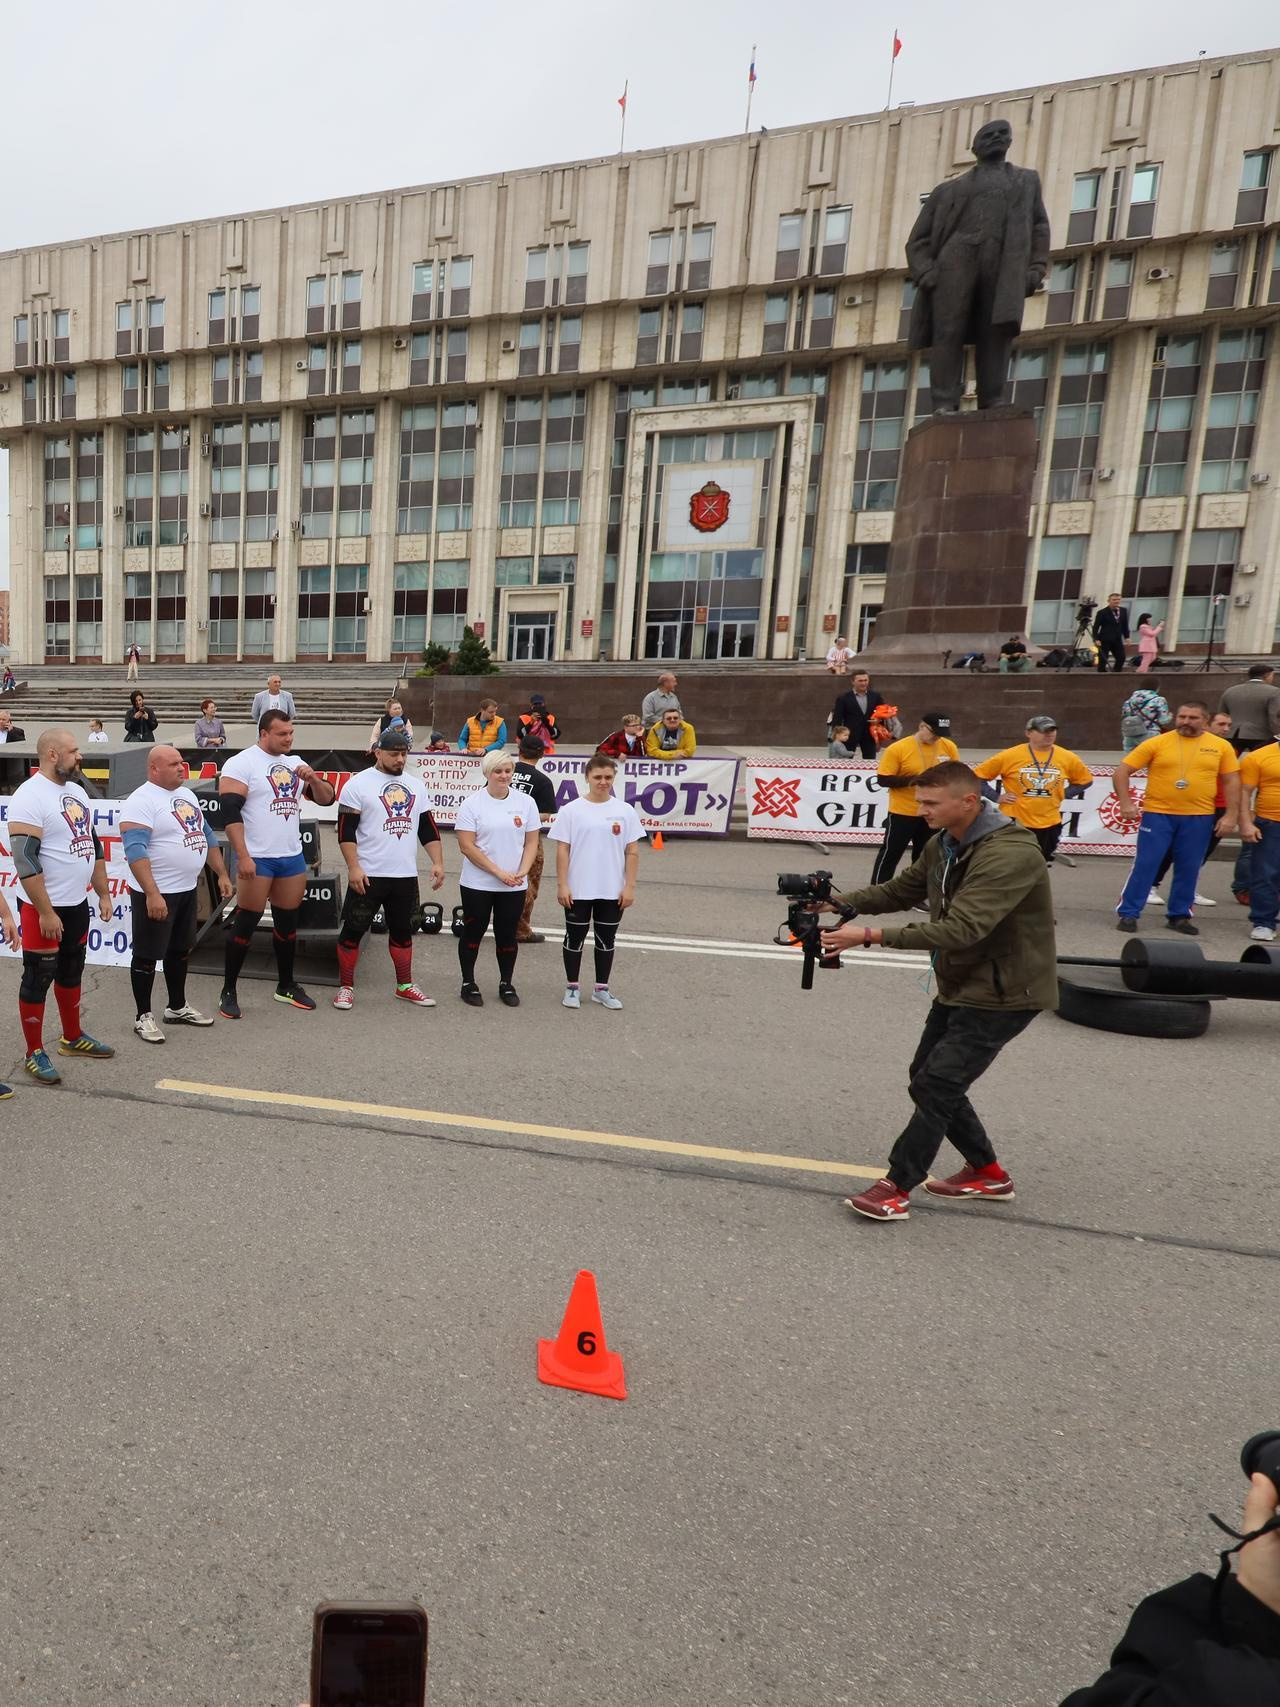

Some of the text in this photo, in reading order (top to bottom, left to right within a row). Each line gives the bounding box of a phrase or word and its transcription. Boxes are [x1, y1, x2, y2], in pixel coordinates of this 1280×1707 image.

[416, 758, 480, 770] 300 метров
[624, 761, 688, 777] ЦЕНТР
[423, 769, 468, 780] от ТГПУ
[384, 821, 413, 831] НАЦИЯ
[425, 916, 436, 924] 24
[577, 1331, 596, 1356] 6
